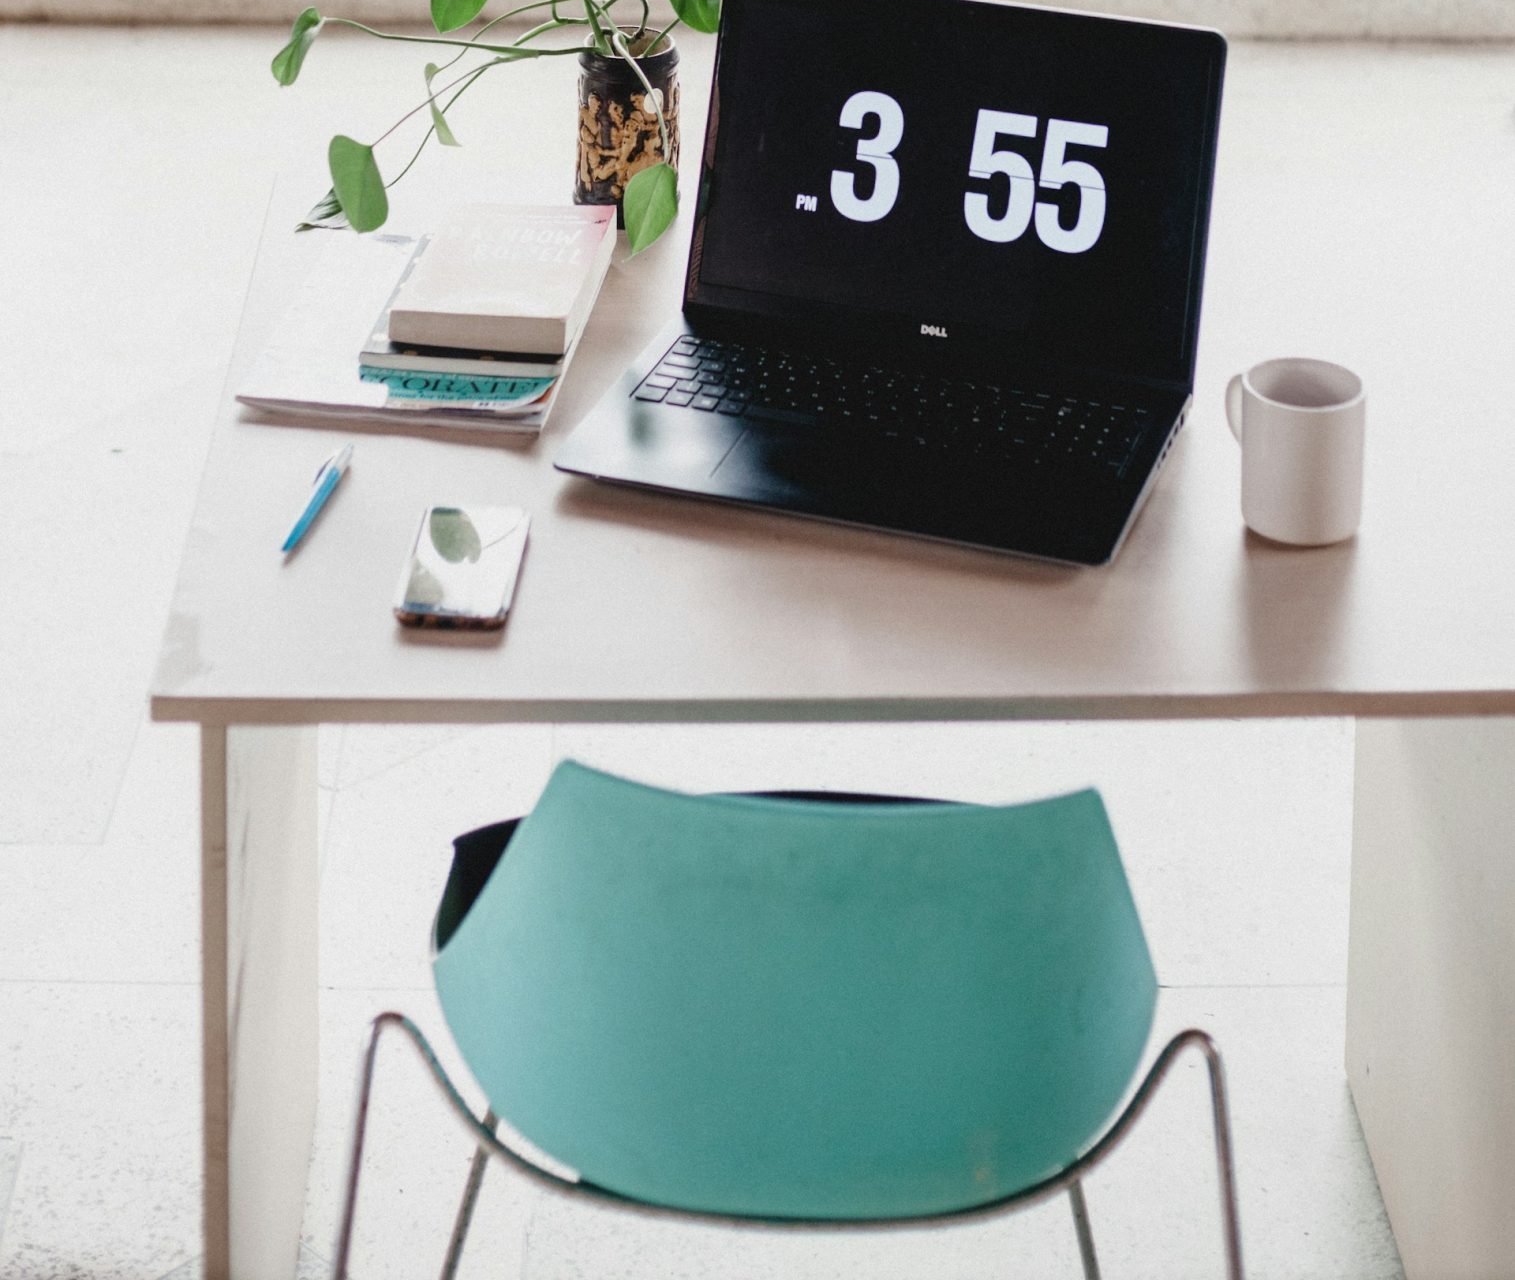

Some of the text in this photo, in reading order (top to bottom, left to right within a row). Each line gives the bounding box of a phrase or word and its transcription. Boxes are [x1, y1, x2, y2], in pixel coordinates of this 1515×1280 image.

[795, 91, 1109, 253] PM 3 55
[920, 323, 948, 338] DELL
